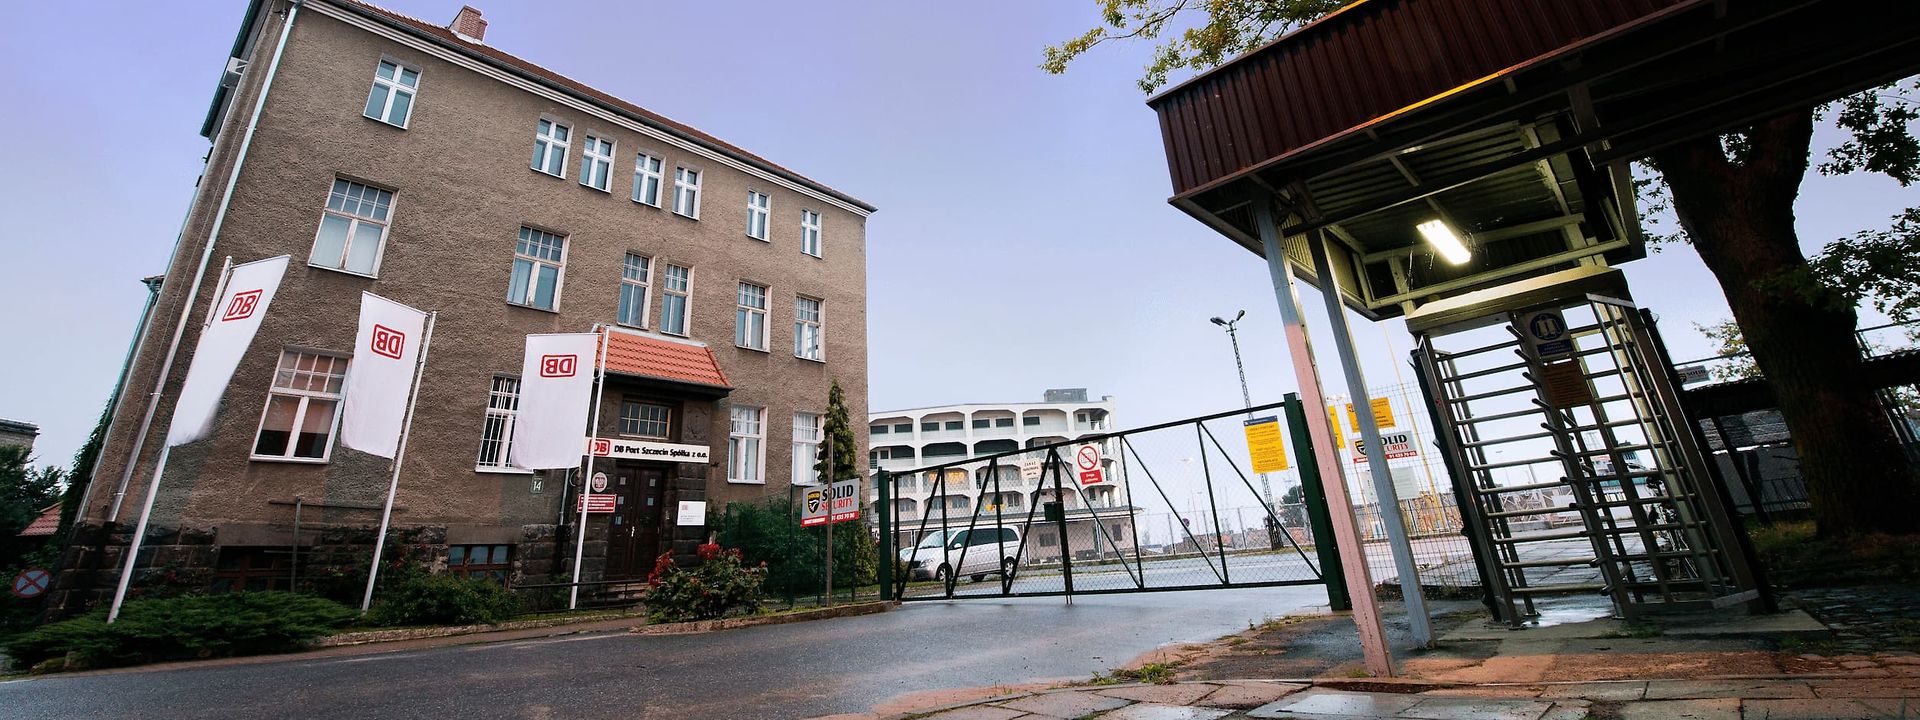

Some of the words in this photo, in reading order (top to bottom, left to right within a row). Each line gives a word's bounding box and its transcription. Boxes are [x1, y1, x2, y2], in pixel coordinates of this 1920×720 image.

[226, 294, 257, 317] DB
[1380, 434, 1408, 446] OLID
[614, 445, 624, 453] DB
[625, 446, 640, 454] Port
[641, 446, 669, 456] Szczecin
[669, 448, 690, 458] Spółka
[533, 480, 542, 491] 14
[821, 498, 852, 511] SEURITY
